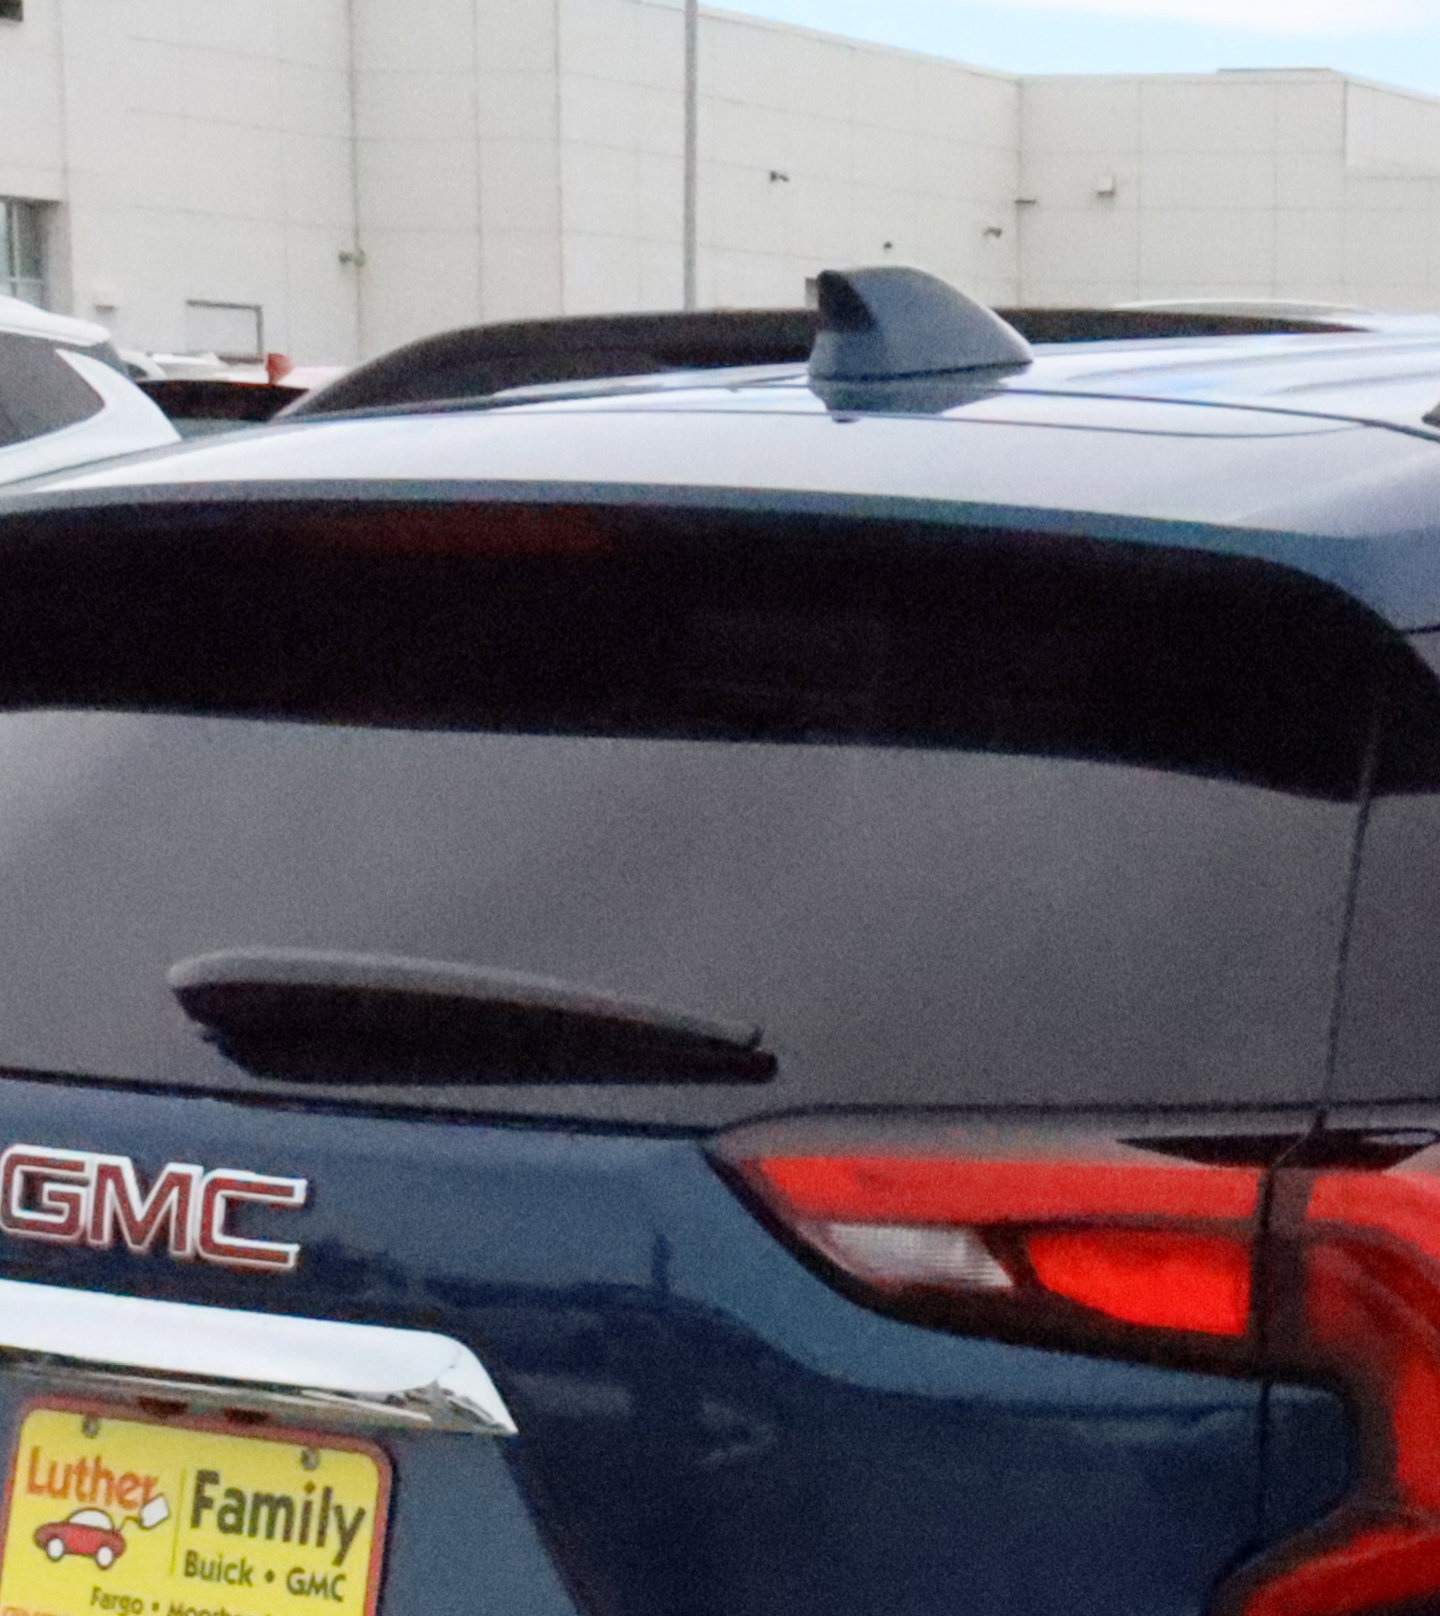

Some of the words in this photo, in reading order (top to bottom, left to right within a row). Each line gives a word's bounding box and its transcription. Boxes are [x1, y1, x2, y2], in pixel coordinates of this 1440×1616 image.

[27, 1446, 158, 1509] Luther
[190, 1469, 366, 1566] Family
[184, 1549, 253, 1587] Buick
[286, 1567, 347, 1602] GMC
